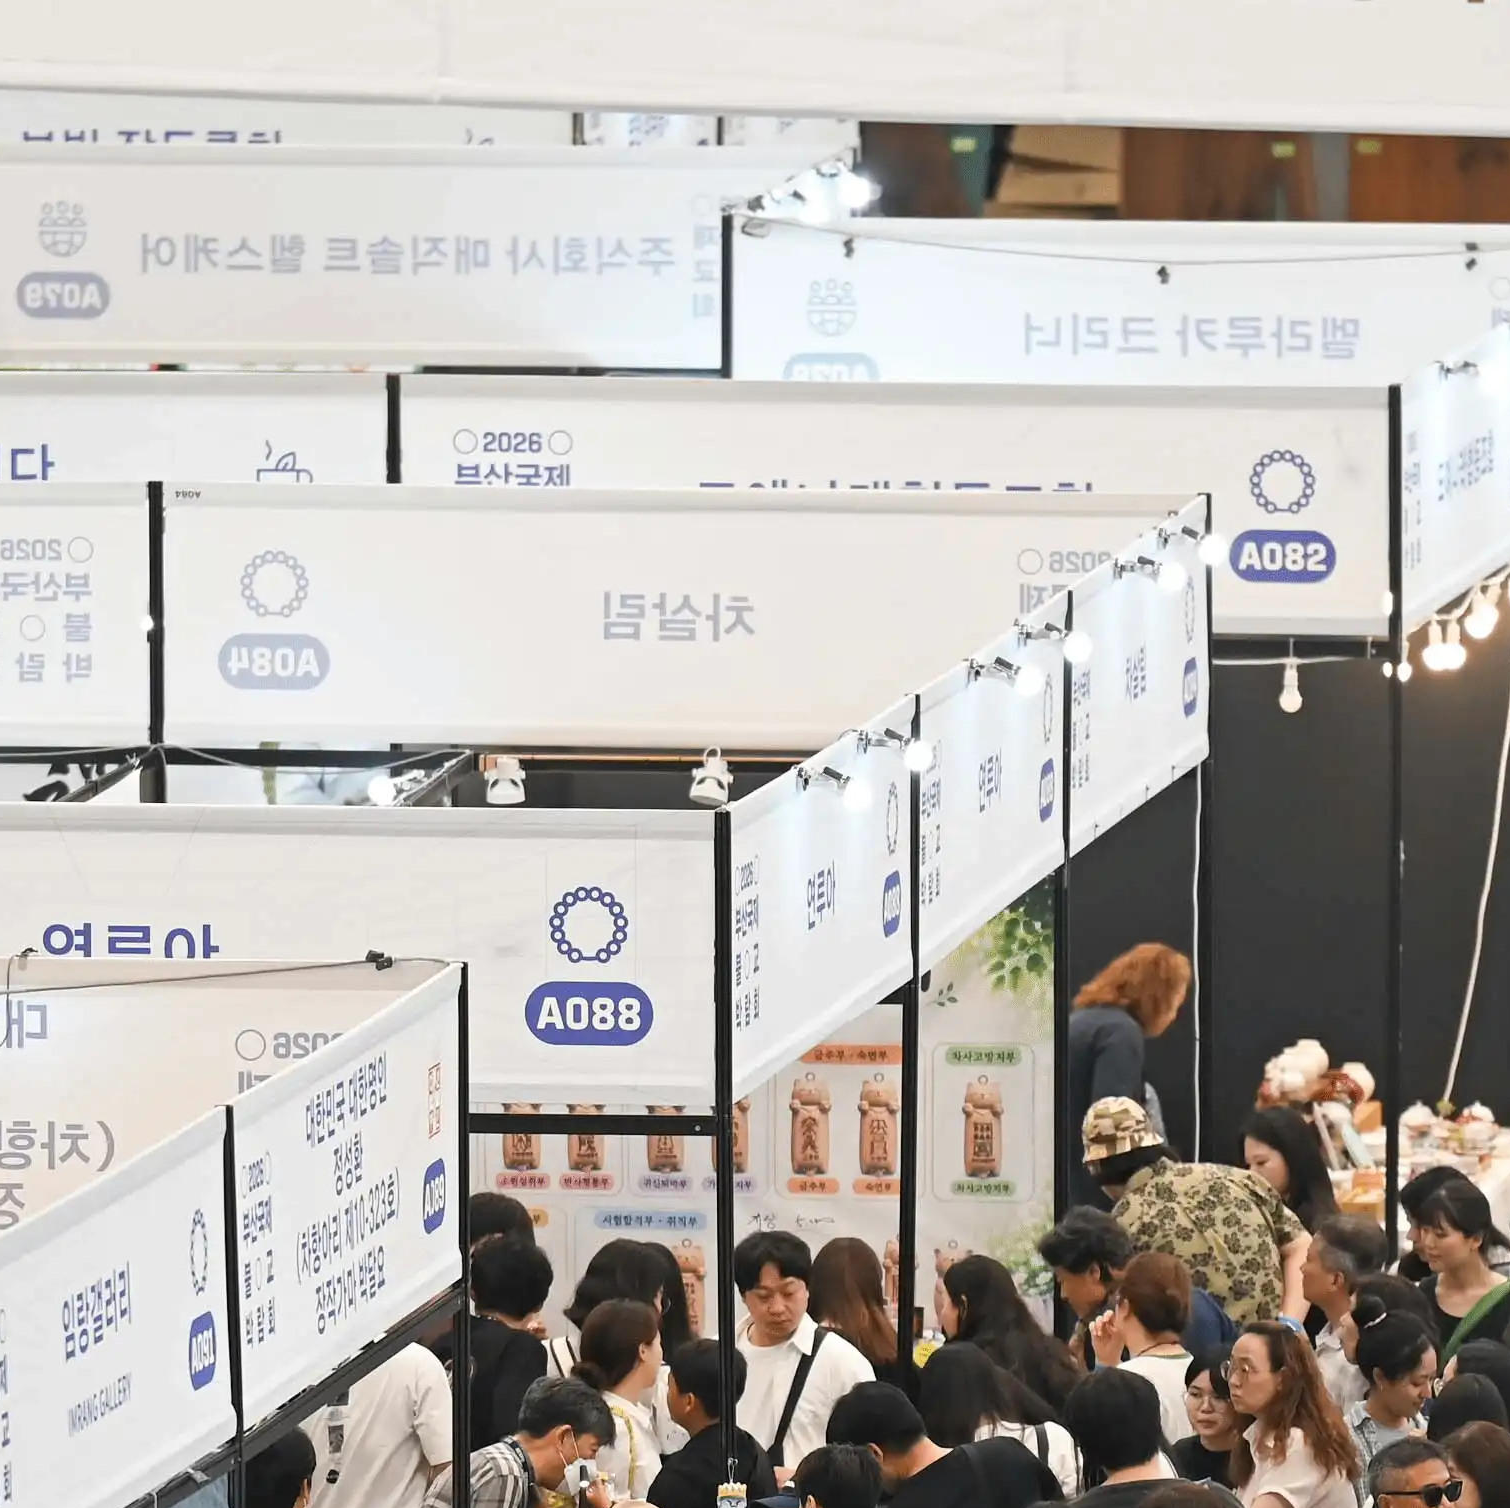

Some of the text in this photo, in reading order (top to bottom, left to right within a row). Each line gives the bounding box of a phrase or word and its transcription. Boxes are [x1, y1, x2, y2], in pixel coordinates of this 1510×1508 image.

[482, 431, 543, 454] 2026
[1238, 541, 1327, 572] A082
[536, 996, 641, 1031] A088
[61, 1259, 132, 1363] 임랑갤러리
[190, 1326, 216, 1375] A091
